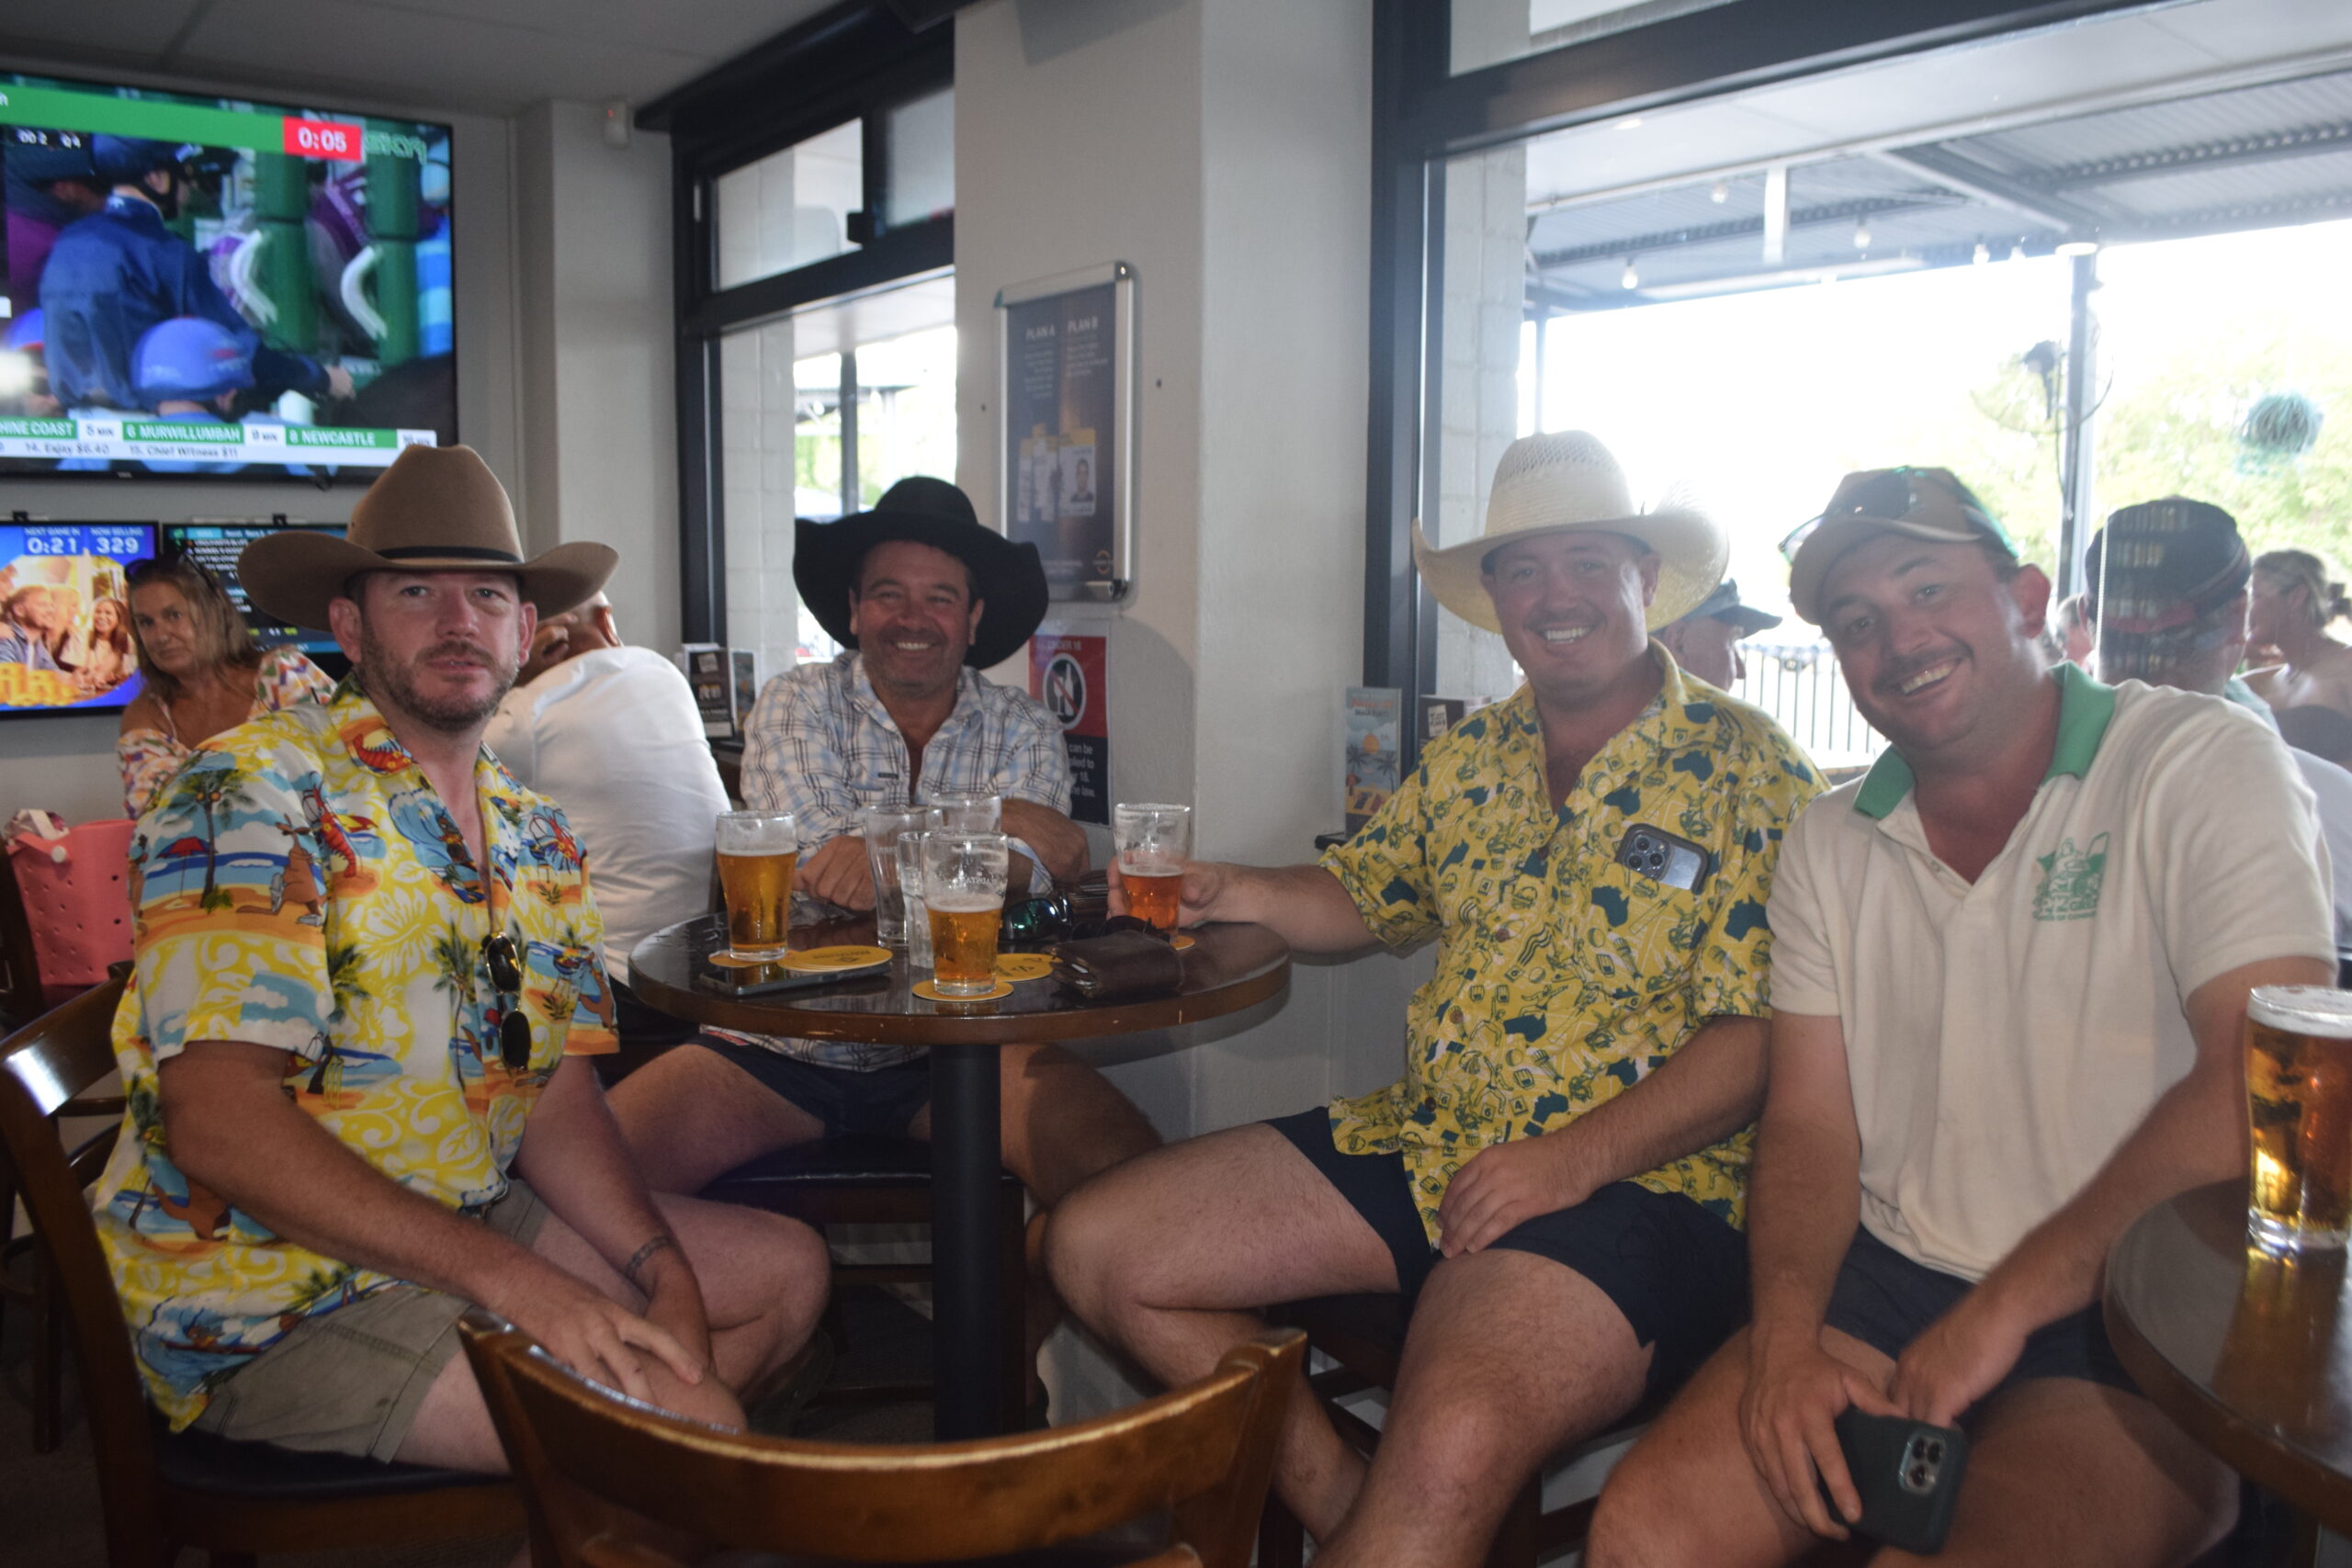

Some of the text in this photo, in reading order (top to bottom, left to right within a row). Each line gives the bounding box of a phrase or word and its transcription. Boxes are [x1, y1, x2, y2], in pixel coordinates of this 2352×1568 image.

[298, 127, 346, 152] 0:05
[1068, 318, 1091, 333] PLAN
[0, 420, 73, 436] HINE COAST
[127, 424, 241, 442] 6 MURWILLUMBAH
[289, 429, 376, 446] 8 NEWCASTLE
[28, 536, 77, 554] 0:21
[96, 536, 139, 554] 329
[1083, 742, 1093, 755] be
[1087, 758, 1094, 769] to
